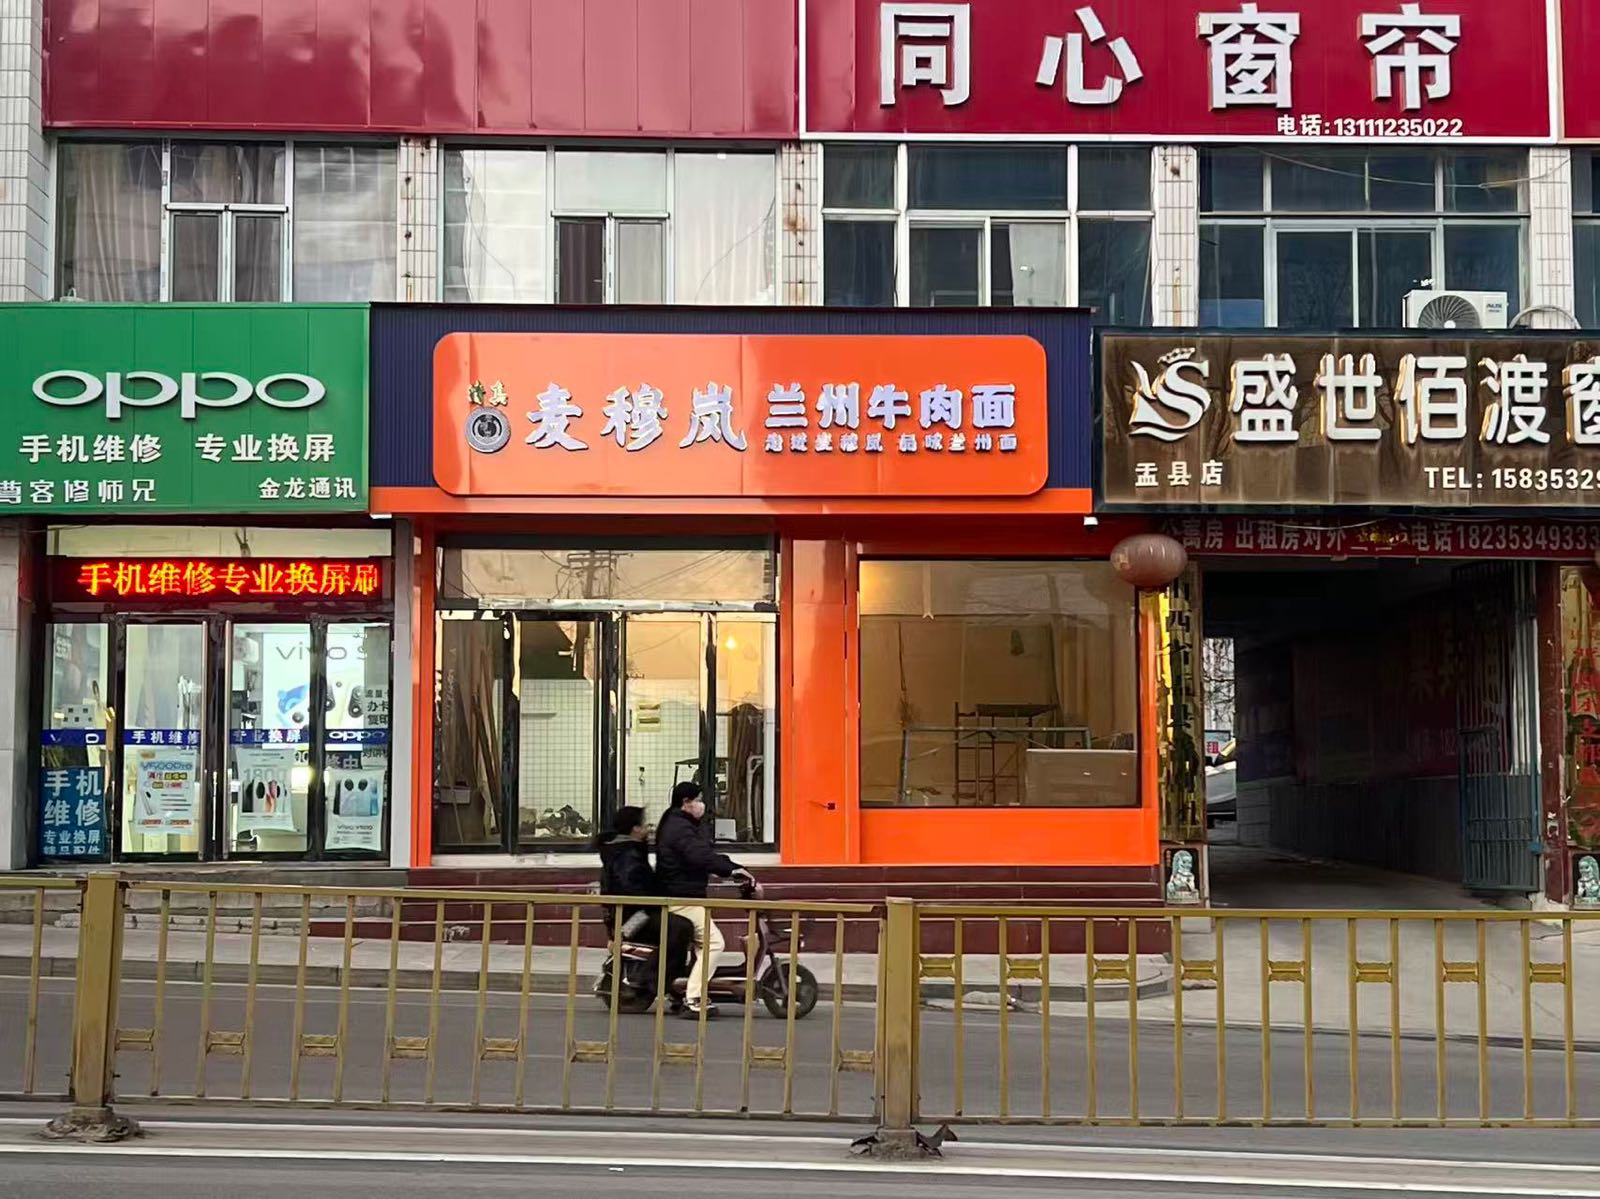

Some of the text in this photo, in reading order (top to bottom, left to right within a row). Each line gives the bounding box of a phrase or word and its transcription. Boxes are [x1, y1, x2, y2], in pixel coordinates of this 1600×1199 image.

[880, 2, 1461, 110] 同心窗帘
[1277, 114, 1464, 136] 电话:13111235022
[524, 381, 749, 452] 麦穆岚
[764, 382, 1018, 430] 兰州牛肉面
[19, 433, 336, 463] 手机维修 专业换屏
[258, 476, 357, 500] 金龙通讯
[44, 770, 100, 796] 手机
[44, 800, 100, 826] 维修
[43, 829, 100, 845] 专业换屏
